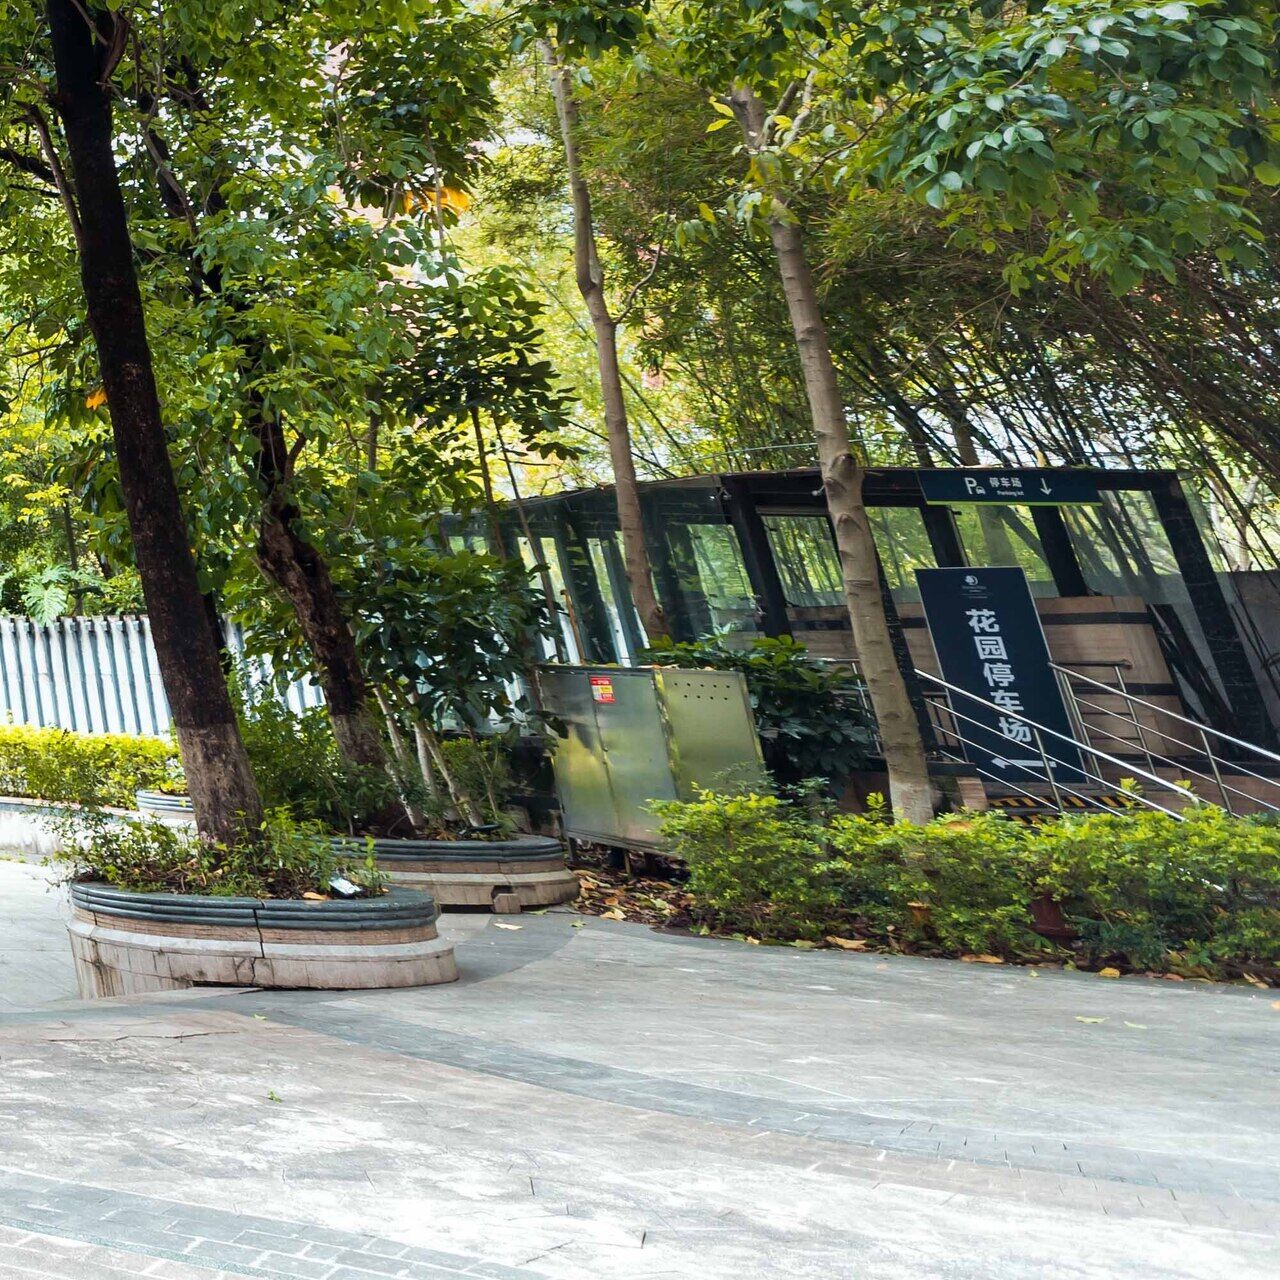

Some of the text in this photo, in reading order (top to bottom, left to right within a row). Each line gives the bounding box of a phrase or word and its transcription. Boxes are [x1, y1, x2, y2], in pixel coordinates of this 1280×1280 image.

[989, 477, 1023, 488] 停车场
[965, 608, 1032, 743] 花园停车场
